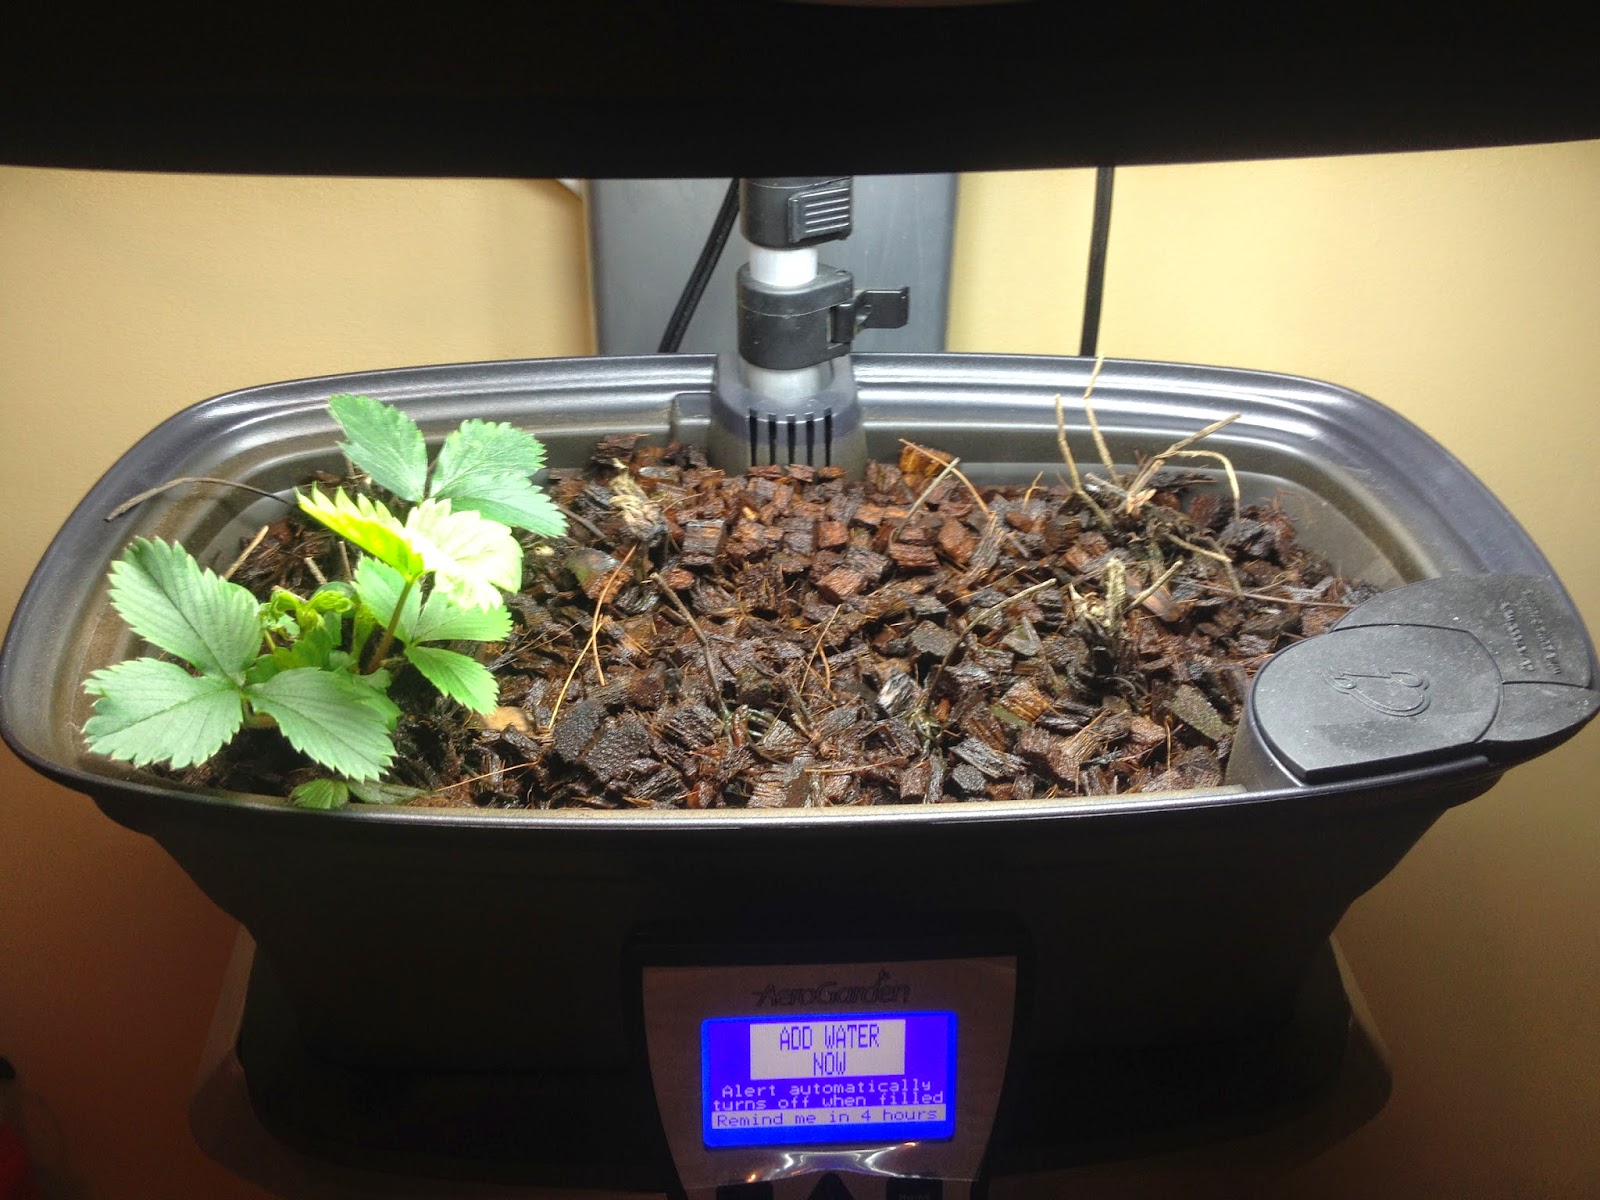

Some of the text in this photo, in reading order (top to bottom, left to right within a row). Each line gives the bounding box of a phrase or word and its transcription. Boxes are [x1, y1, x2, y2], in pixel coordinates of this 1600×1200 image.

[752, 970, 910, 1007] AeroGarden
[780, 1024, 880, 1050] ADD WATER
[813, 1051, 846, 1076] NOW
[721, 1078, 931, 1098] Alert automatically
[713, 1091, 944, 1111] turns off when filled
[718, 1108, 937, 1127] Remind me in 4 hours
